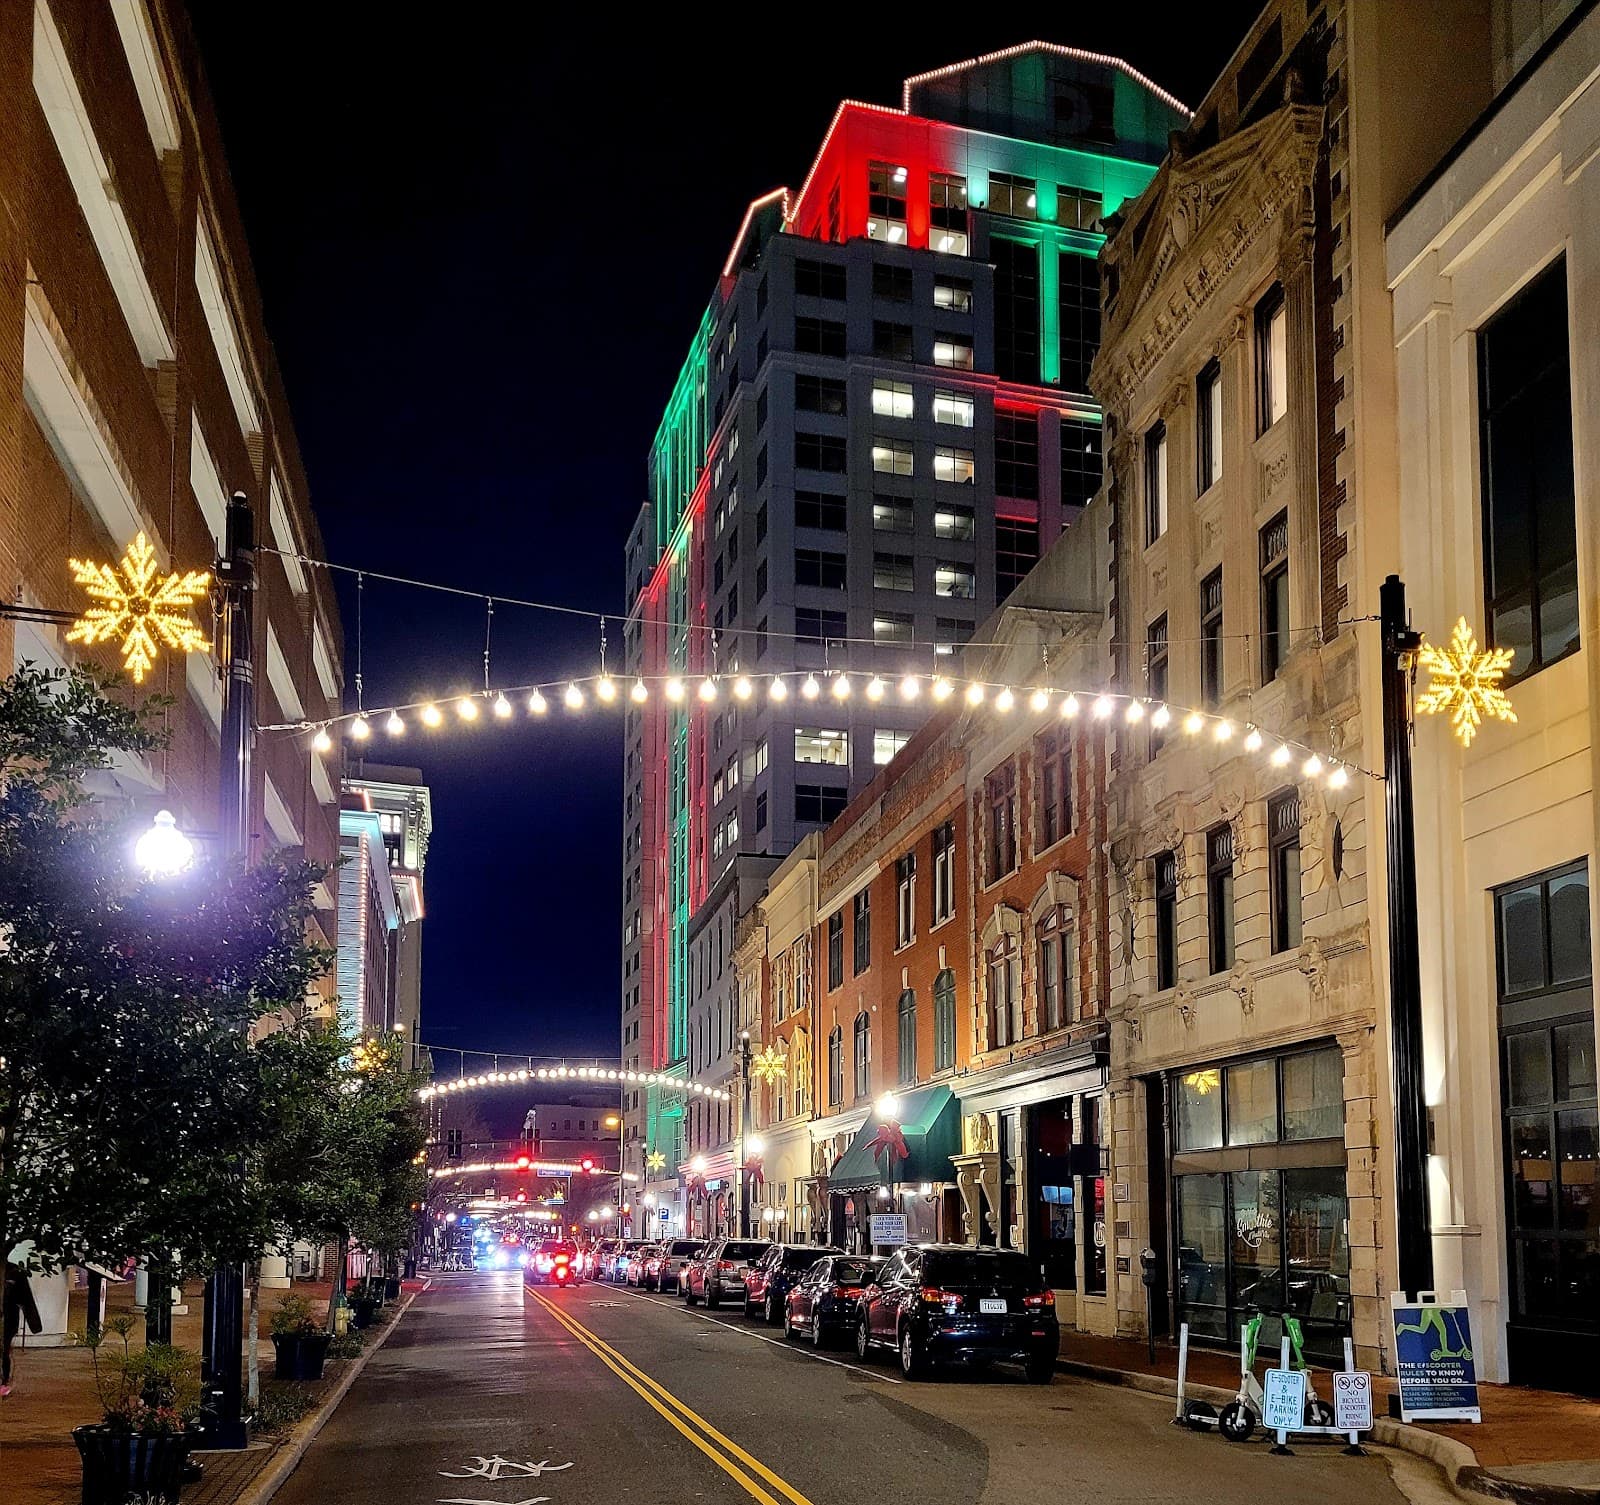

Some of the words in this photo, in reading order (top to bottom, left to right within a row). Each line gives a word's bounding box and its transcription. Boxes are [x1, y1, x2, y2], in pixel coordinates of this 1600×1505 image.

[660, 1209, 668, 1219] P
[1271, 1373, 1300, 1385] E-SCOOTER
[1281, 1384, 1288, 1394] &
[1270, 1393, 1297, 1406] E-BIKE
[1269, 1403, 1298, 1416] PARKING
[1273, 1415, 1293, 1426] ONLY
